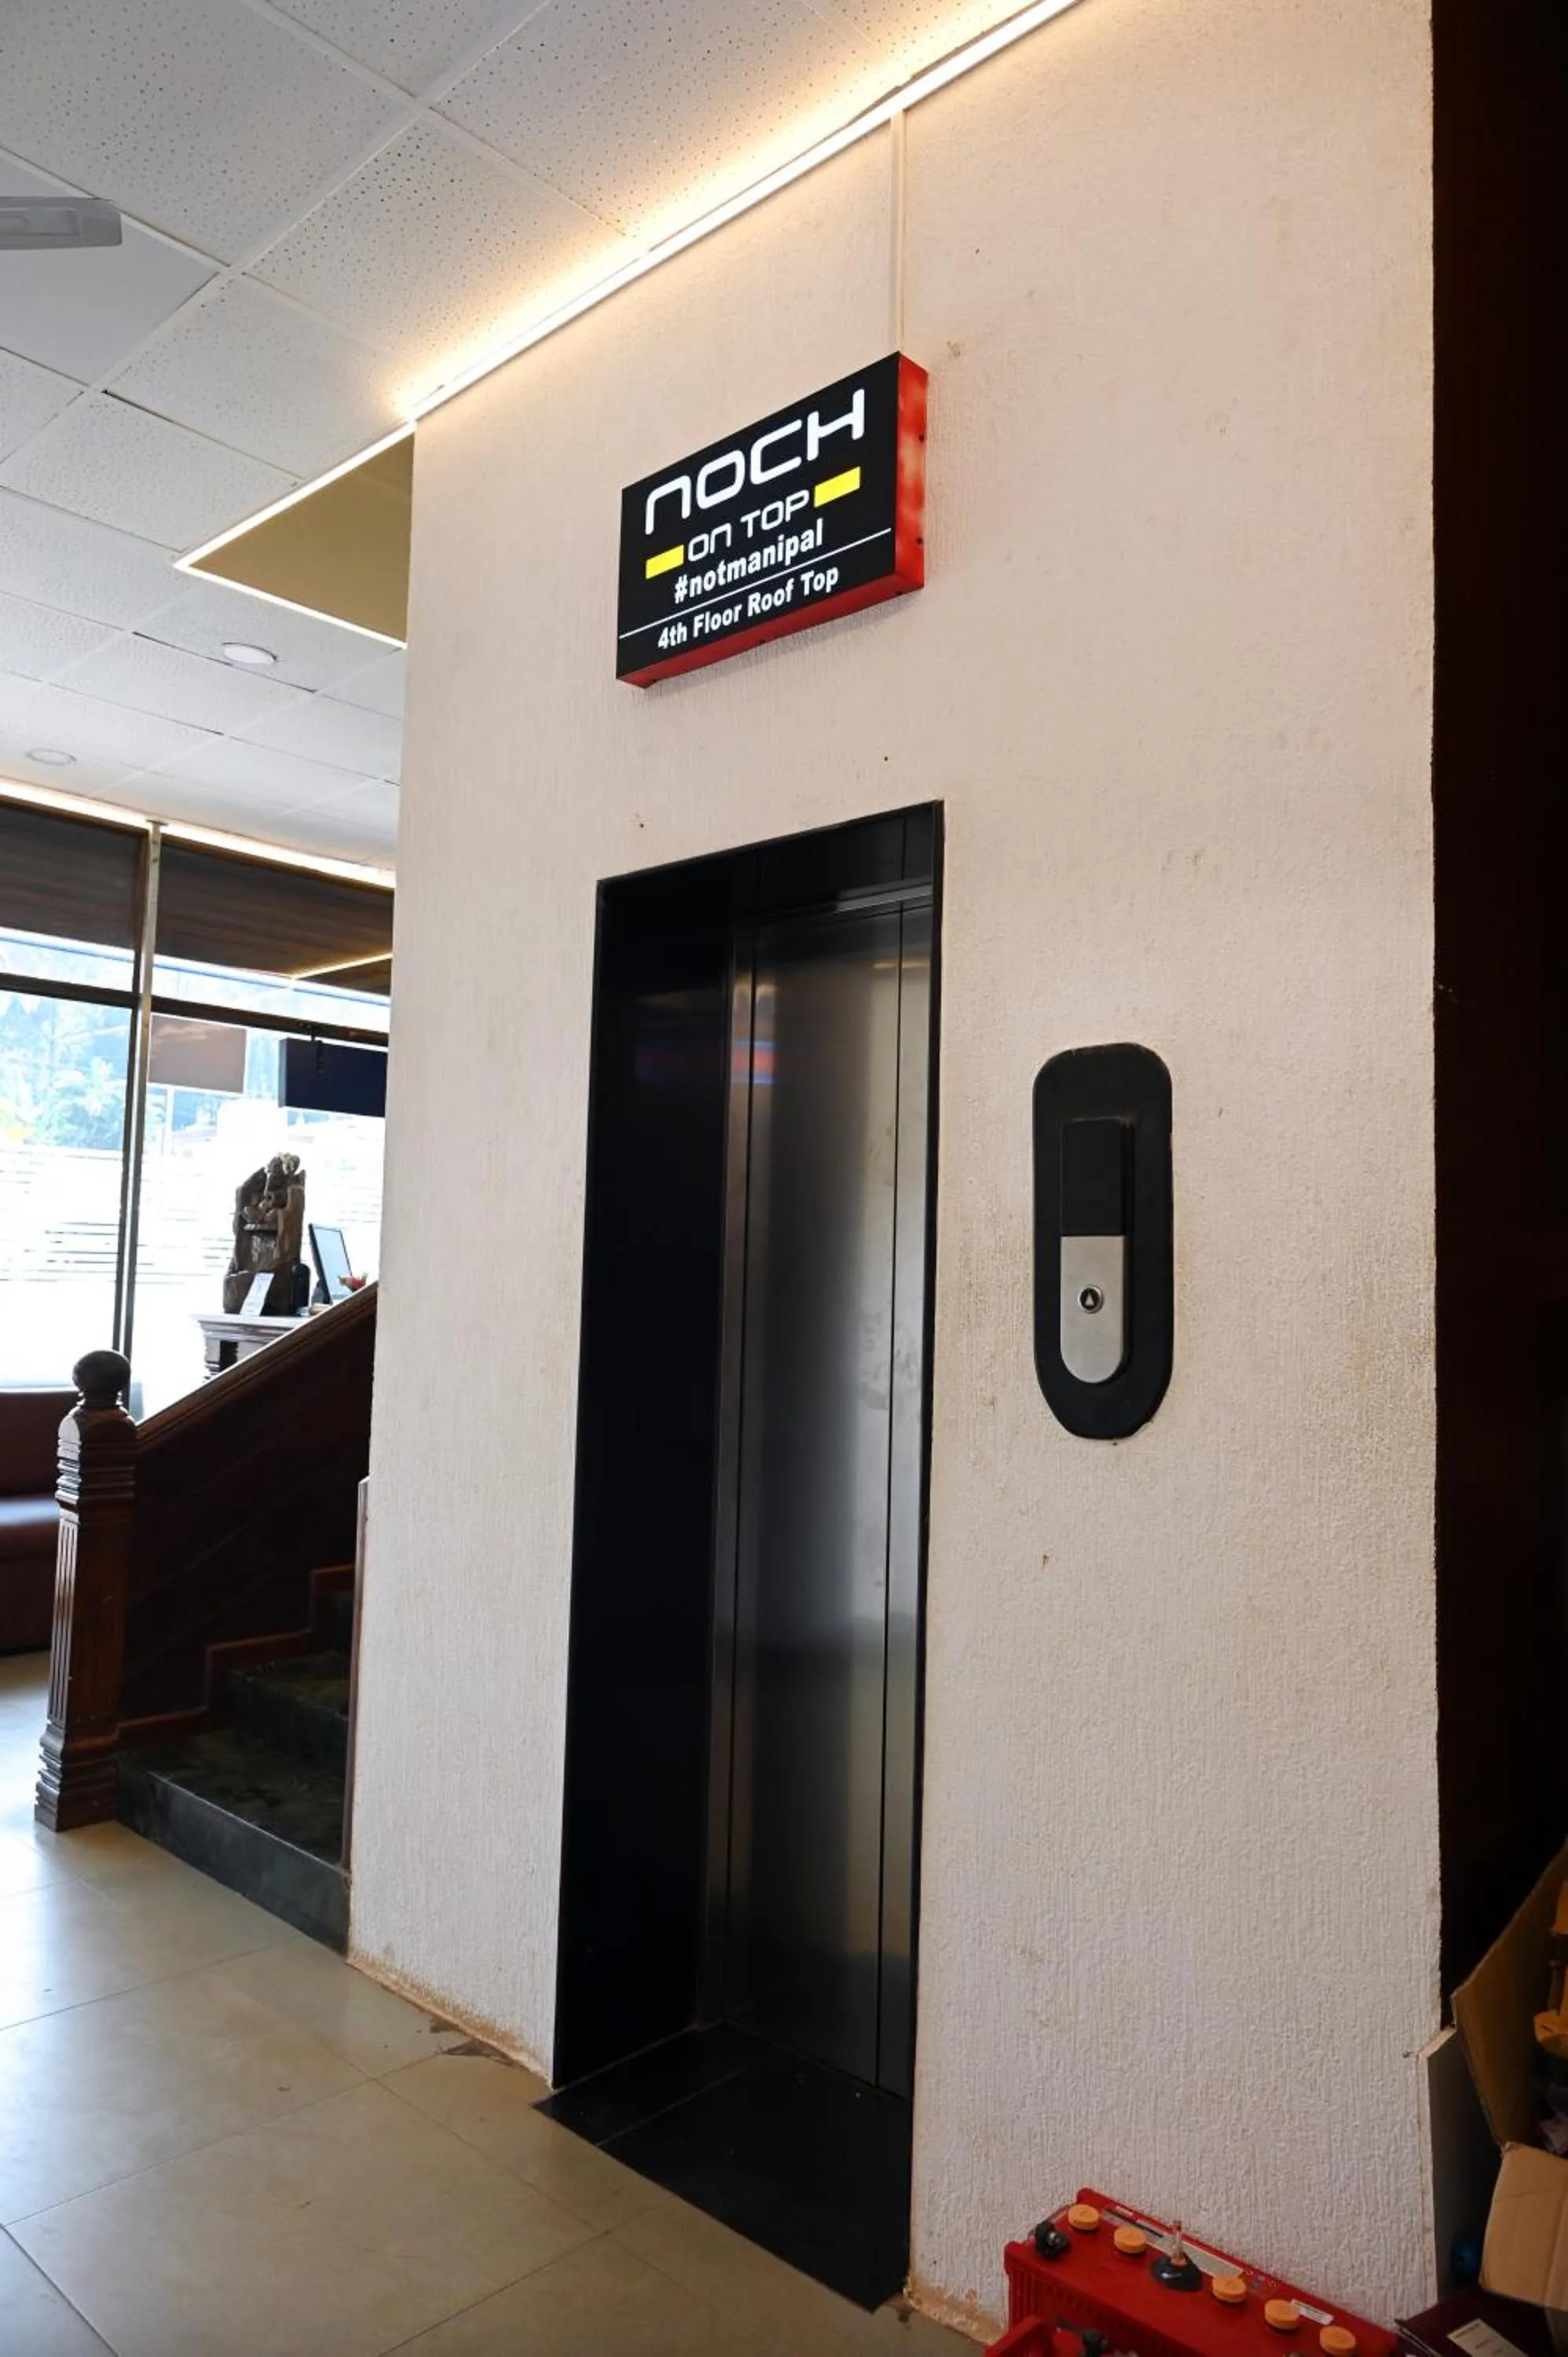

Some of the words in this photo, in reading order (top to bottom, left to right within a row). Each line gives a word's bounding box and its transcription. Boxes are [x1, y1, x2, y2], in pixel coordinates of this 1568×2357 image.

[645, 388, 865, 535] NOCH
[674, 517, 823, 604] #notmanipal
[687, 522, 732, 562] ON
[740, 489, 810, 538] TOP
[658, 621, 687, 650] 4th
[692, 603, 743, 638] Floor
[747, 577, 794, 617] Roof
[800, 566, 839, 596] Top
